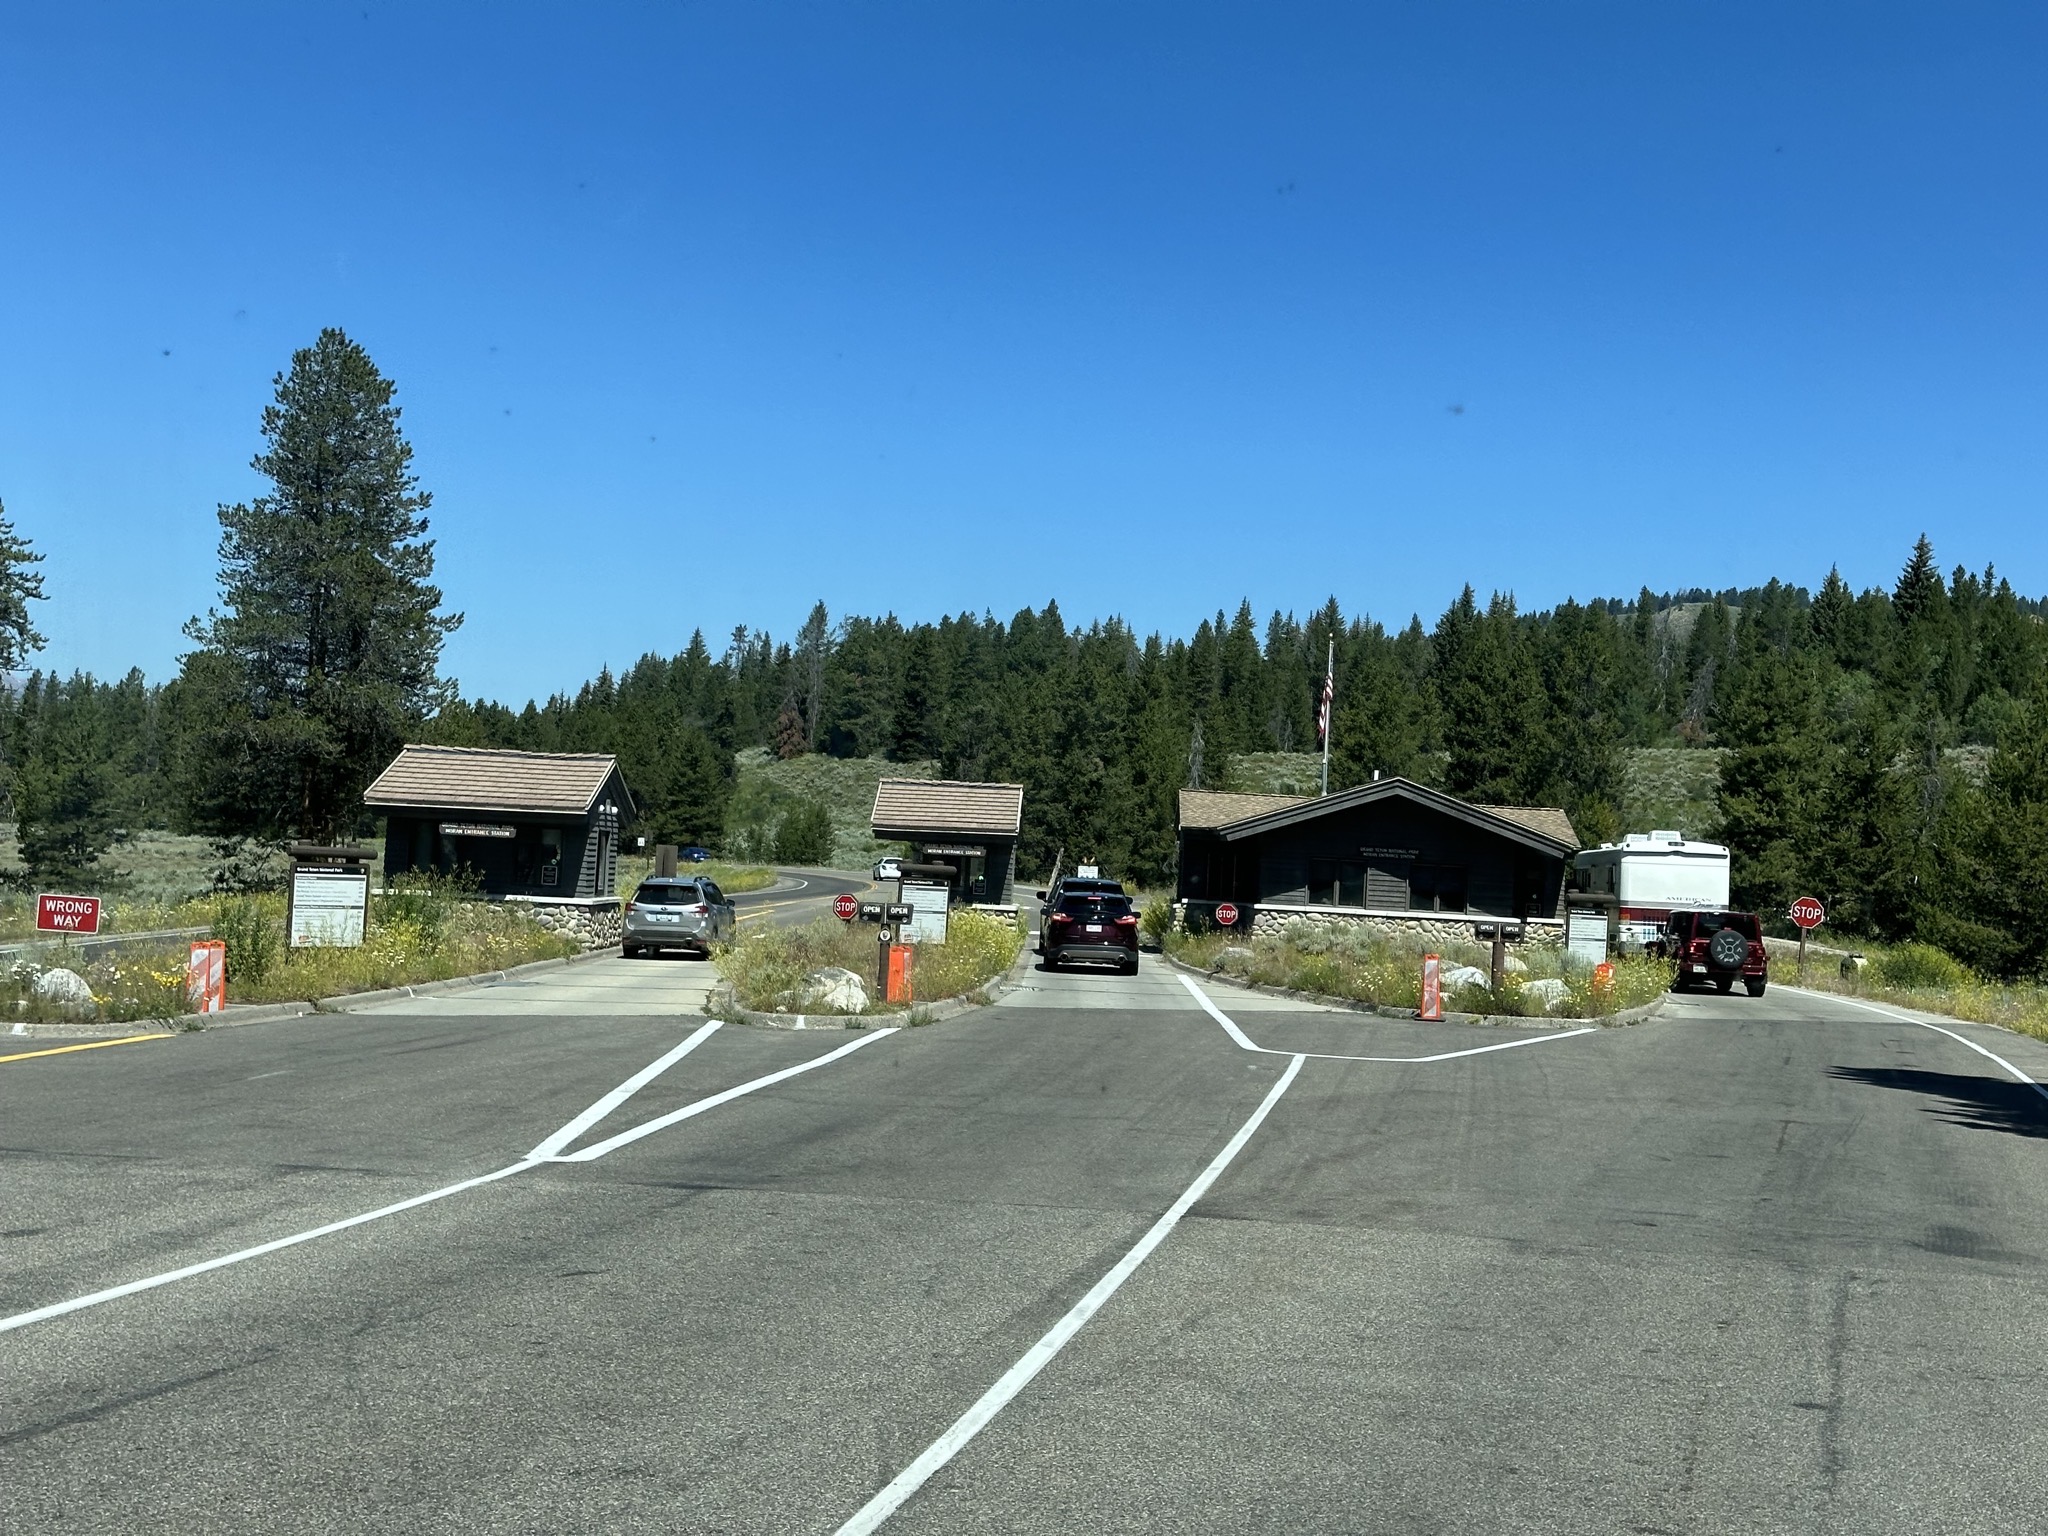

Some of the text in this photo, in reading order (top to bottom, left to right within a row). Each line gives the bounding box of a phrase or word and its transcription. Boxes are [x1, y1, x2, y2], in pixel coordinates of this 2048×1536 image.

[46, 900, 92, 914] WRONG
[836, 903, 856, 912] STOP
[1794, 906, 1821, 920] STOP
[54, 914, 82, 927] WAY
[1218, 910, 1236, 918] STOP
